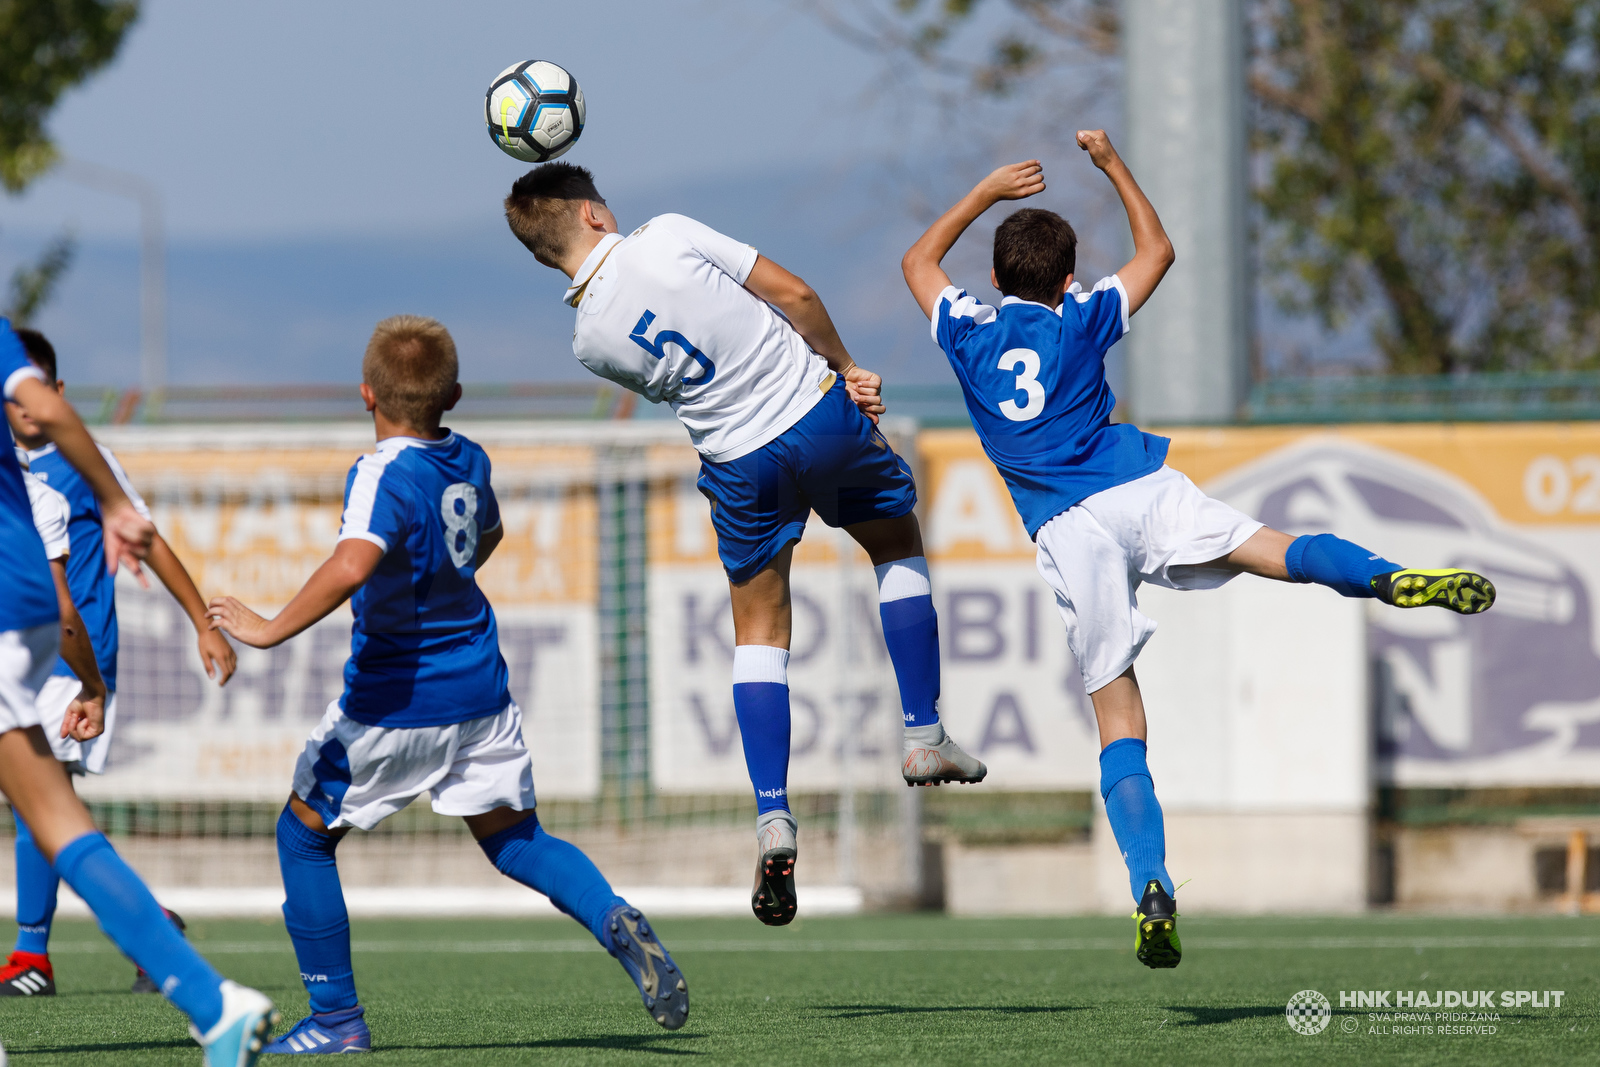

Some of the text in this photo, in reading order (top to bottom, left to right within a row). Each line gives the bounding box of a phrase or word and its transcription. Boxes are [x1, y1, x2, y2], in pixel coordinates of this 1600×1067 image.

[629, 309, 716, 386] 5
[997, 348, 1045, 422] 3
[1521, 454, 1600, 515] 02
[440, 482, 478, 569] 8
[689, 691, 1038, 759] VOZA
